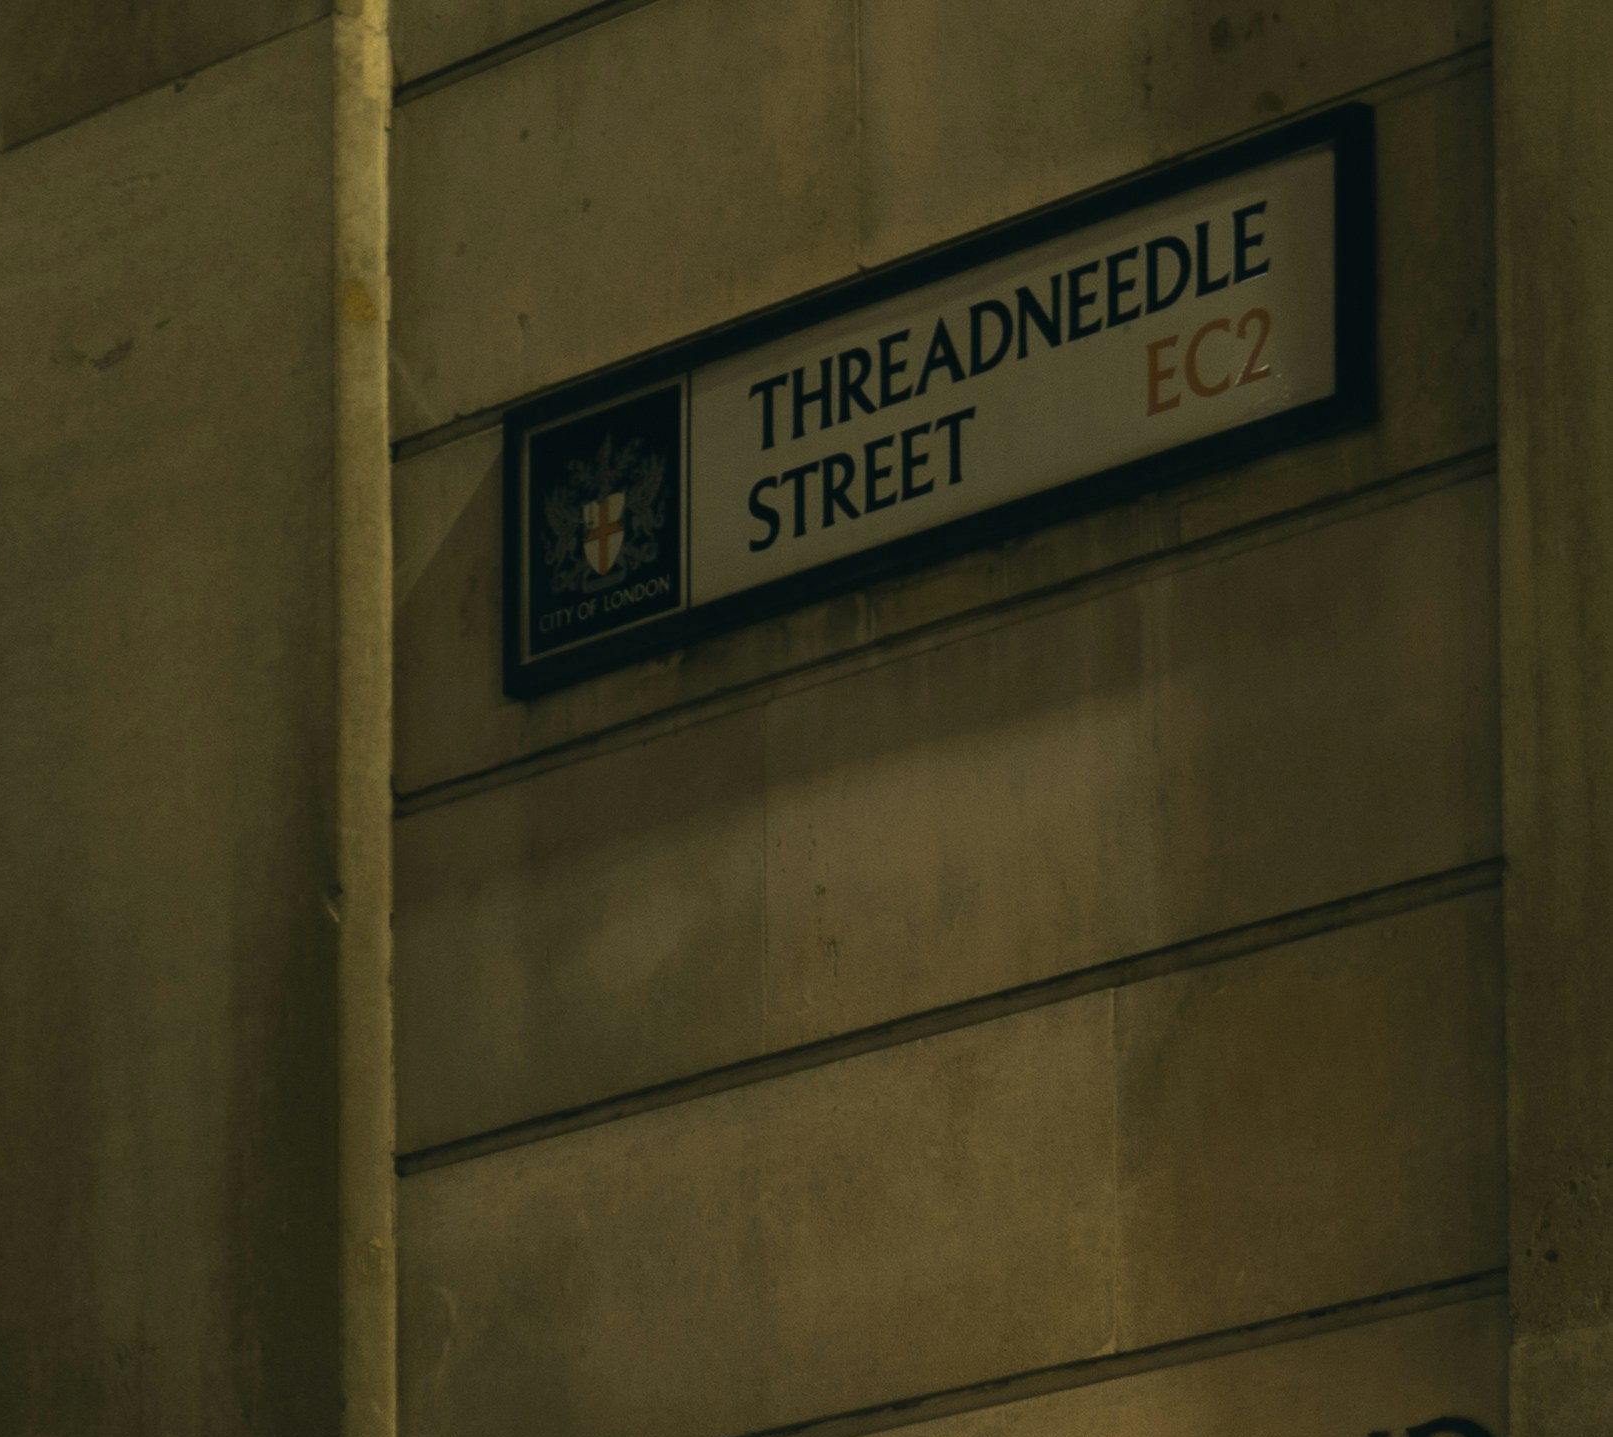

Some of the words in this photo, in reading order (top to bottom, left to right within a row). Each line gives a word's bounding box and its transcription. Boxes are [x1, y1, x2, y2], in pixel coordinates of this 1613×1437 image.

[748, 201, 1272, 450] THREADNEEDLE
[1145, 306, 1272, 417] EC2
[748, 406, 976, 551] STREET
[539, 607, 572, 632] CITY
[577, 599, 597, 620] OF
[603, 574, 670, 611] LONDON
